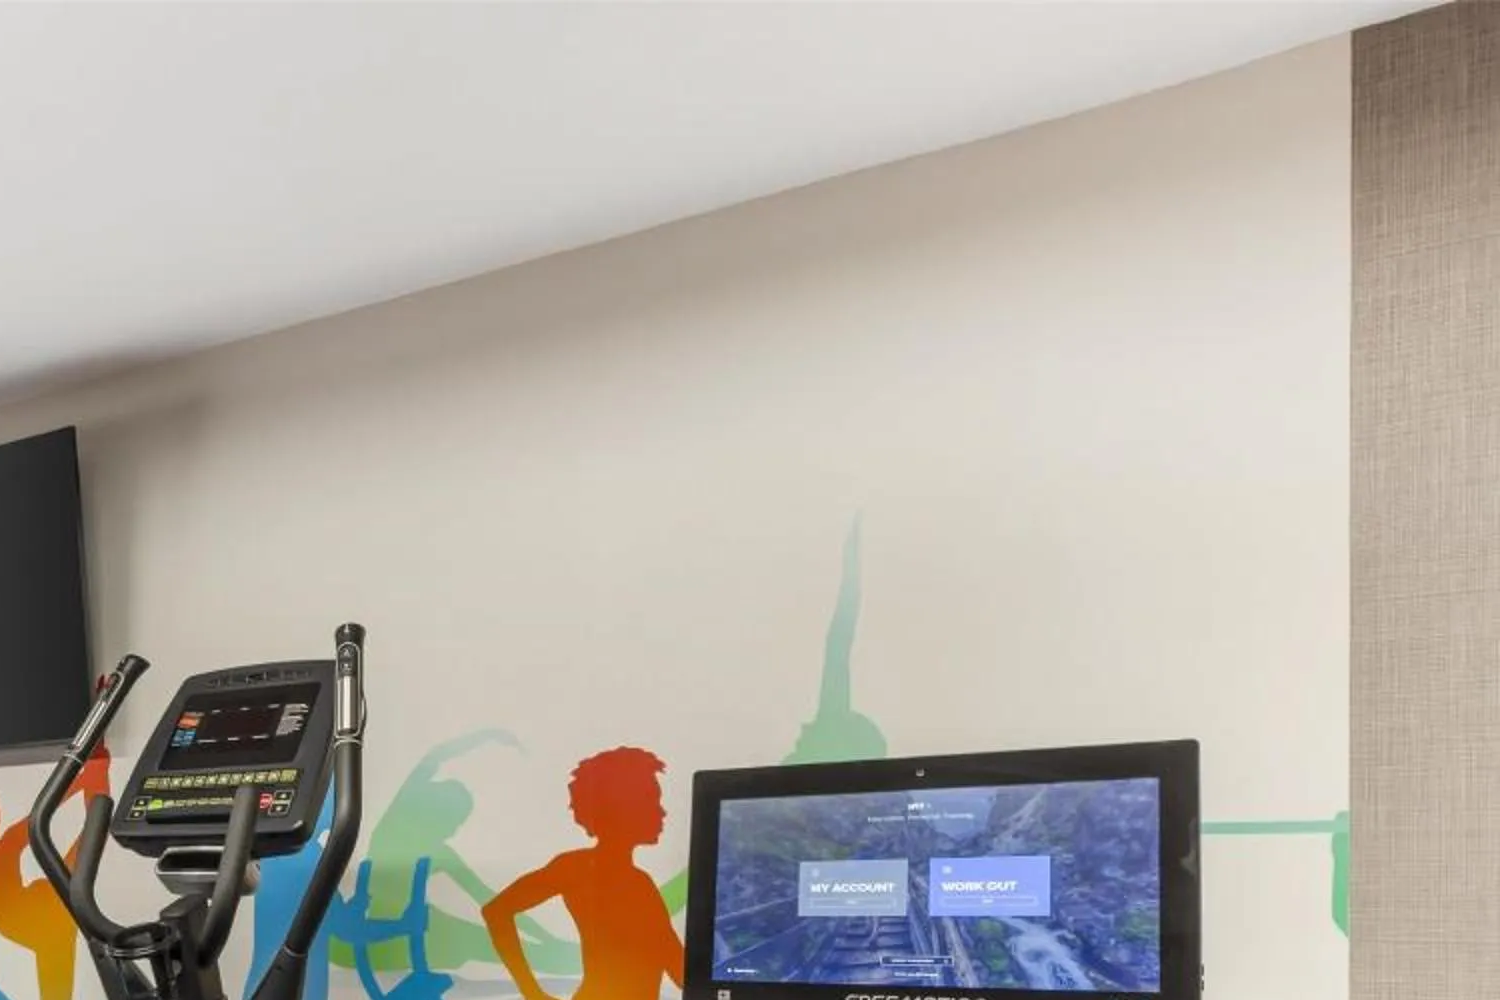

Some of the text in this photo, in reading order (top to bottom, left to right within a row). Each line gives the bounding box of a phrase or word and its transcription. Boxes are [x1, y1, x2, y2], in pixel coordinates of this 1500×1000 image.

[811, 881, 895, 894] MY ACCOUNT
[941, 880, 1018, 893] WORK OUT
